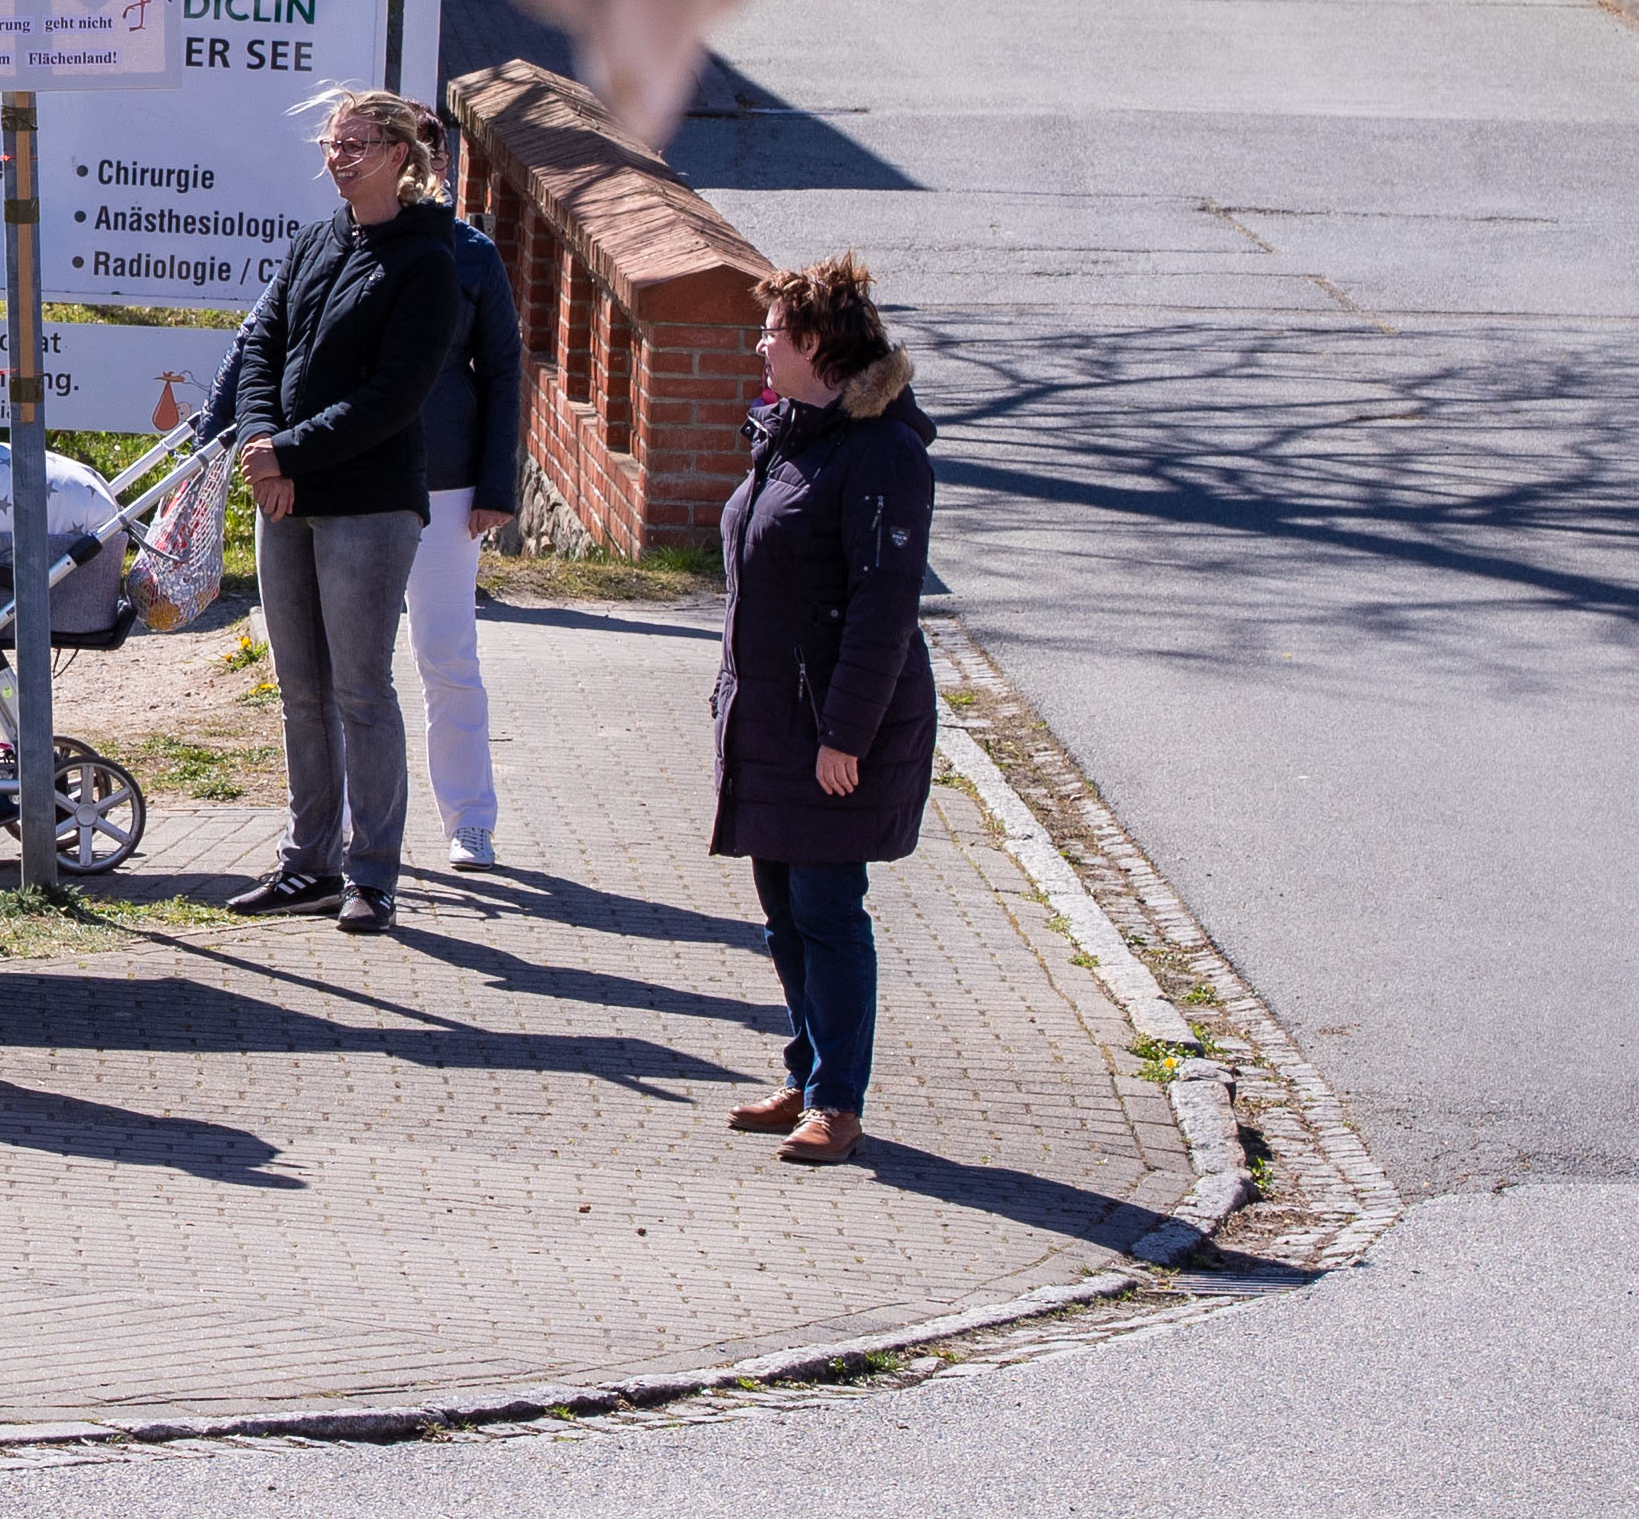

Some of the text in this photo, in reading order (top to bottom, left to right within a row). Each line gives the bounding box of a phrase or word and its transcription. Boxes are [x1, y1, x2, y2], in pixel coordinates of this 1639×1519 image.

[44, 16, 74, 31] geht
[78, 15, 112, 29] nicht
[28, 51, 118, 65] Flächenland!
[246, 39, 313, 71] SEE
[98, 159, 215, 193] Chirurgie
[94, 204, 301, 243] Anästhesiologie
[93, 251, 231, 286] Radiologie
